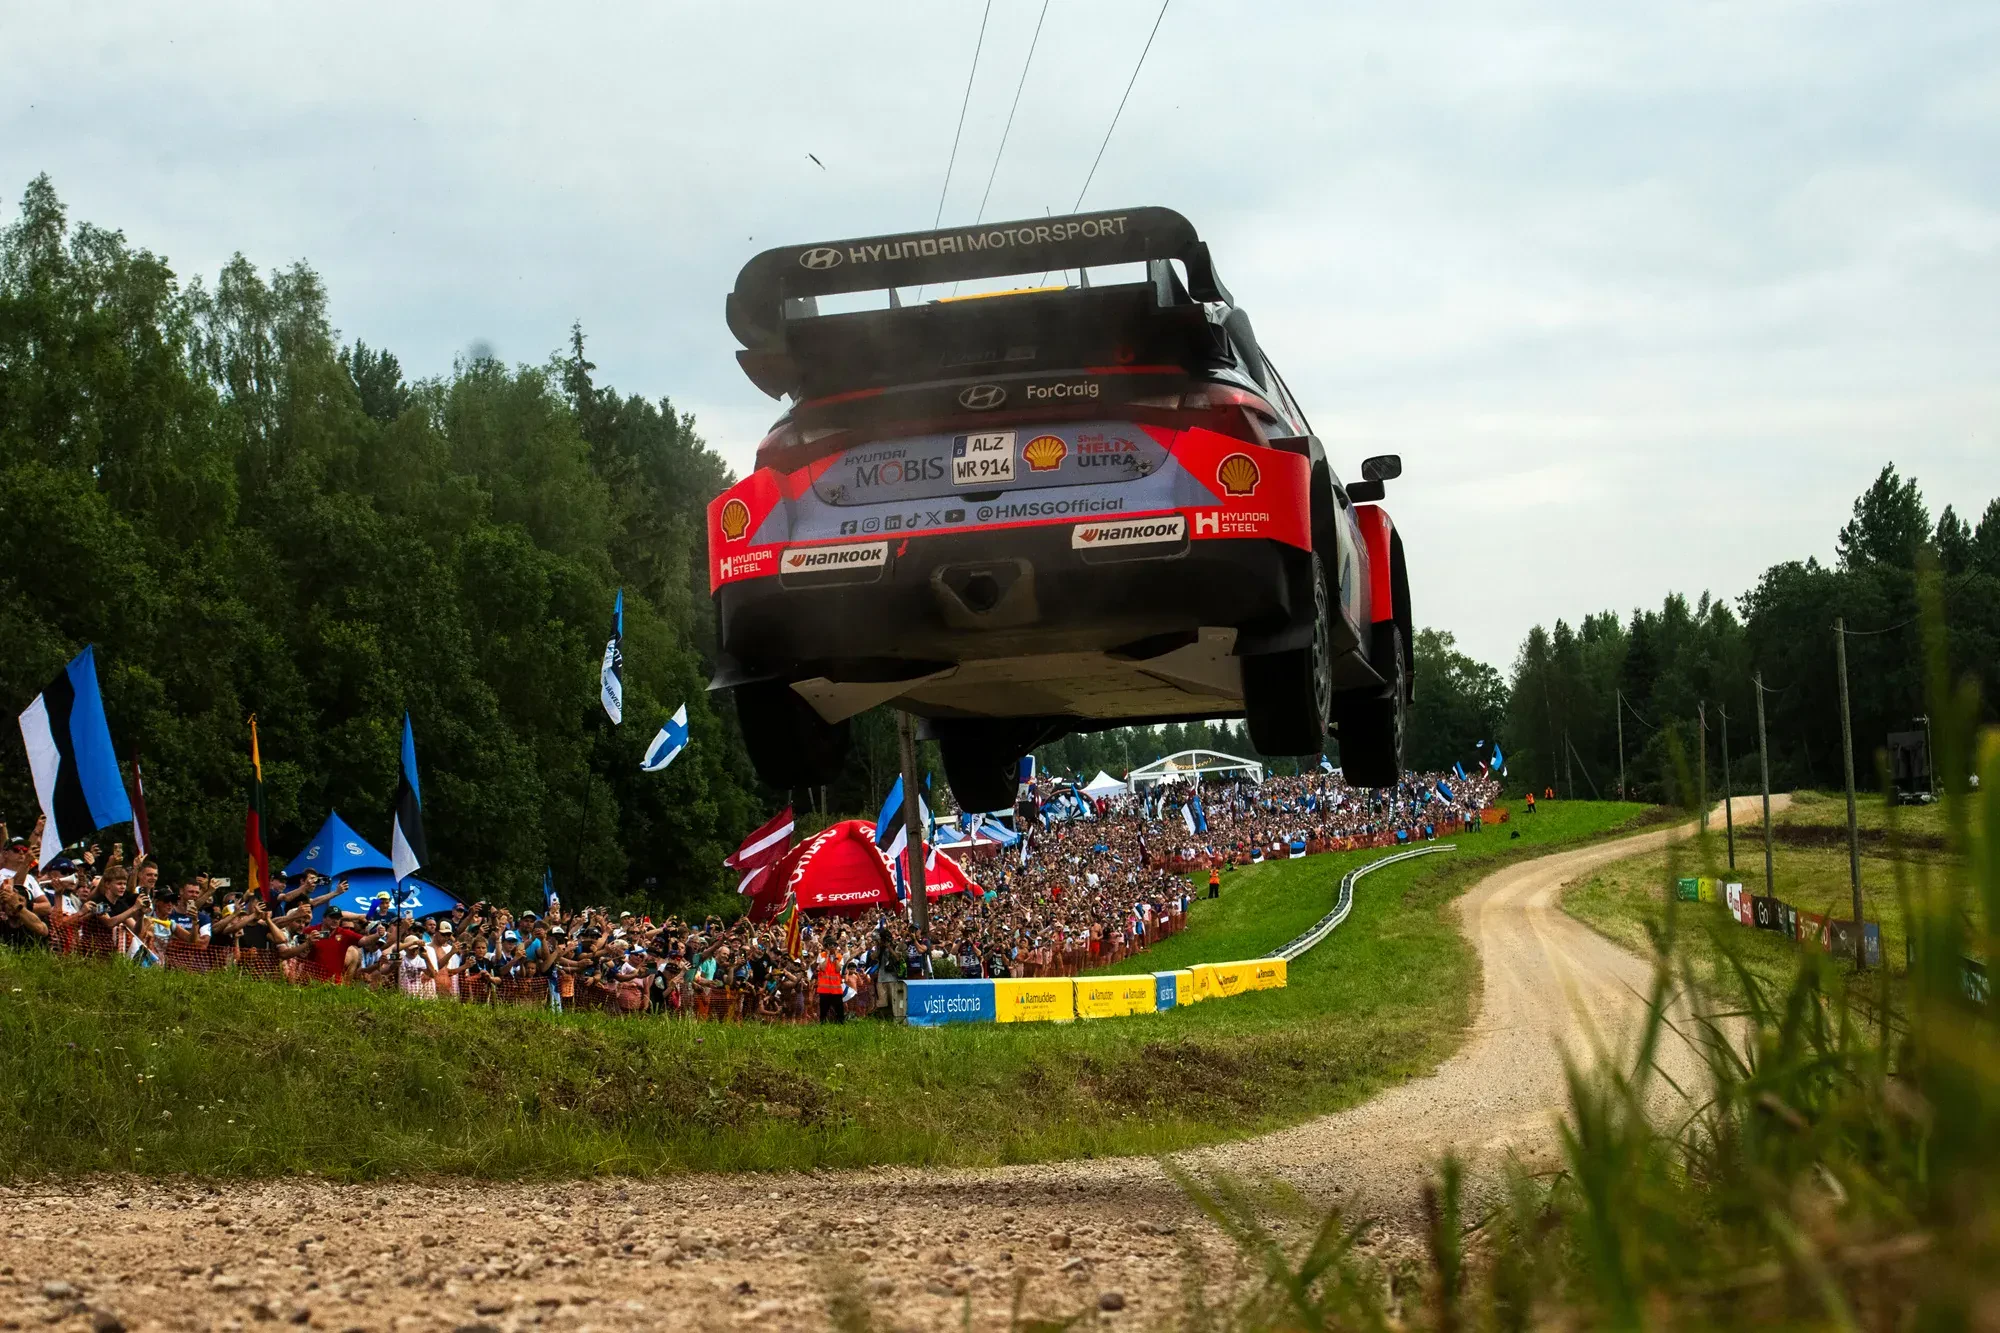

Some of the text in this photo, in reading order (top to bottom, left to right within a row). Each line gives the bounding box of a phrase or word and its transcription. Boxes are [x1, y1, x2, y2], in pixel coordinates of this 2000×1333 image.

[850, 216, 1129, 264] HYUNDAI MOTORSPORT
[1027, 380, 1099, 399] ForCraig
[972, 437, 1004, 452] ALZ
[1077, 440, 1138, 454] HELIX
[845, 449, 907, 466] HYUNDAI
[1077, 453, 1136, 468] ULTRA
[855, 457, 945, 488] MOBIS
[957, 458, 1010, 478] WR 914
[976, 497, 1123, 522] @HMSGOfficial
[1221, 512, 1270, 522] HYUNDAI
[1222, 523, 1258, 533] STEEL
[732, 550, 772, 565] HYUNDAI
[733, 563, 761, 576] STEEL
[828, 889, 880, 902] SPORTLAND
[924, 994, 981, 1014] visit estonia
[1025, 992, 1057, 1003] Ramudden
